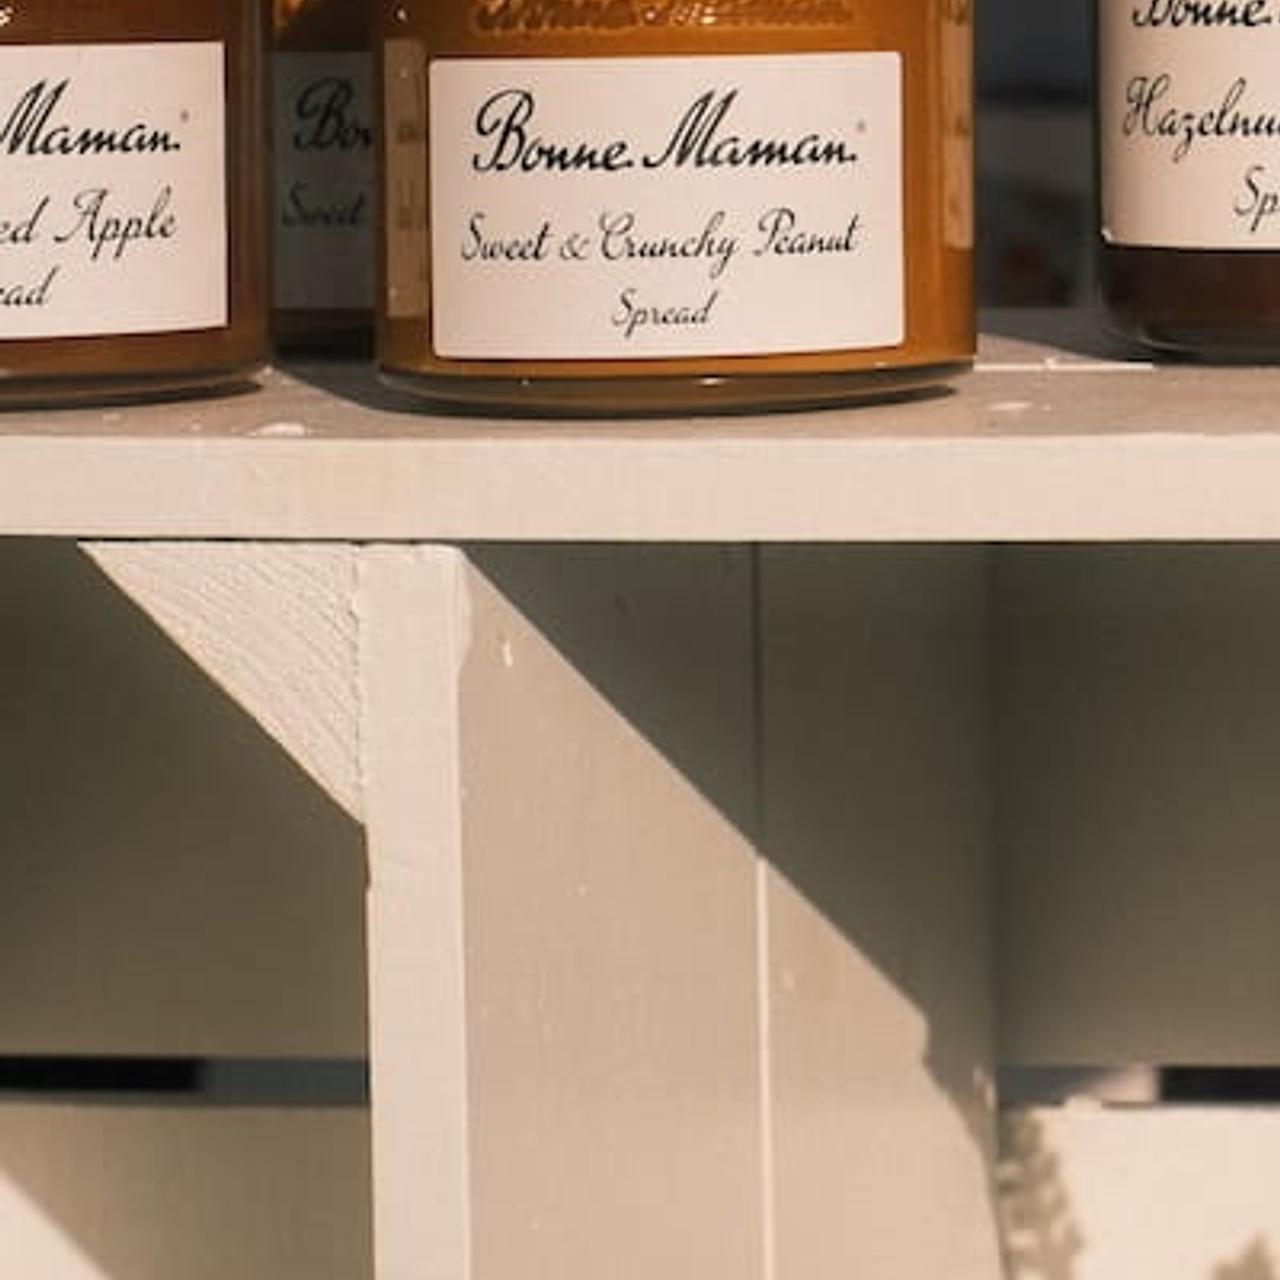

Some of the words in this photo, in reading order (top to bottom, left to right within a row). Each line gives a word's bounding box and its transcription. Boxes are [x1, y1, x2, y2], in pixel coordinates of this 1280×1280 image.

[472, 89, 635, 173] Bonne
[53, 186, 176, 261] Apple
[461, 212, 552, 261] Sweet
[559, 234, 589, 260] &
[599, 211, 739, 279] Crunchy
[753, 208, 859, 256] Peanut
[612, 288, 718, 338] Spread
